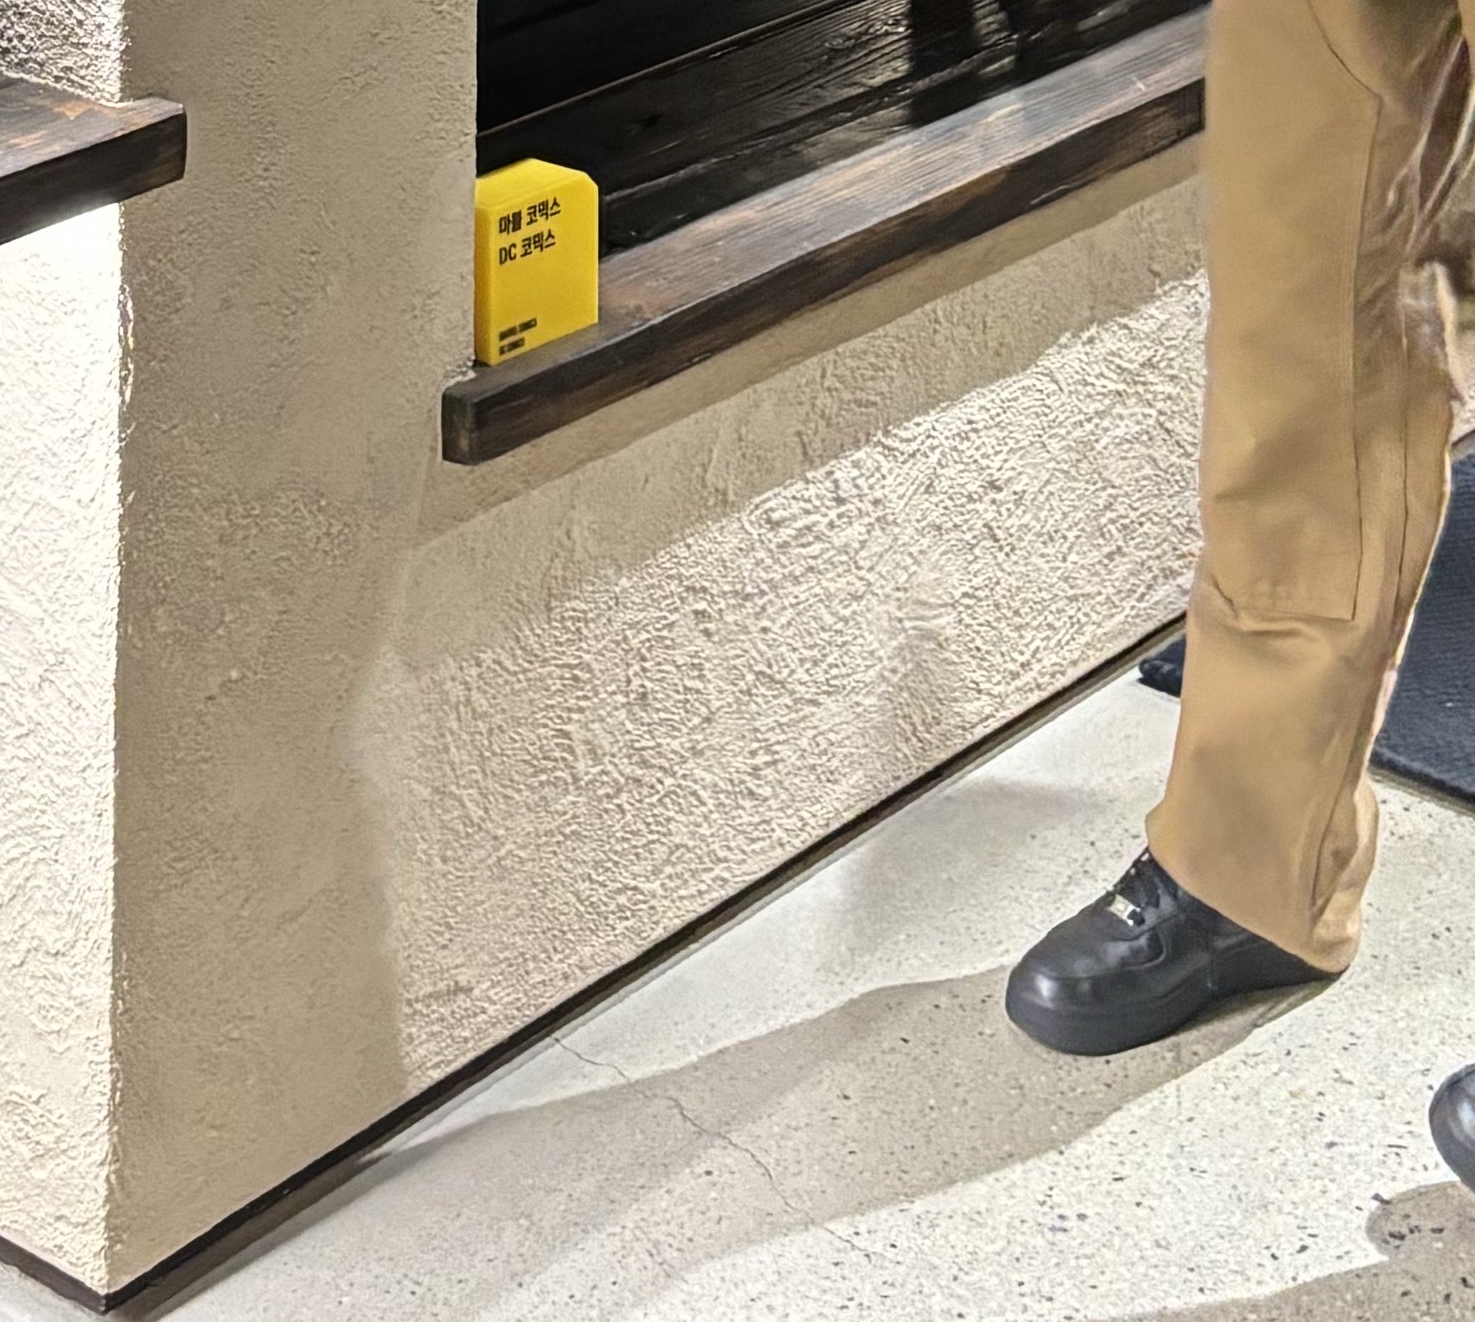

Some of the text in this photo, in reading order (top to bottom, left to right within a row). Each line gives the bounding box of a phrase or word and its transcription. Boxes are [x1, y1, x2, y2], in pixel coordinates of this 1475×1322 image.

[498, 196, 562, 236] 마블 코믹스
[499, 228, 557, 266] DC 코믹스
